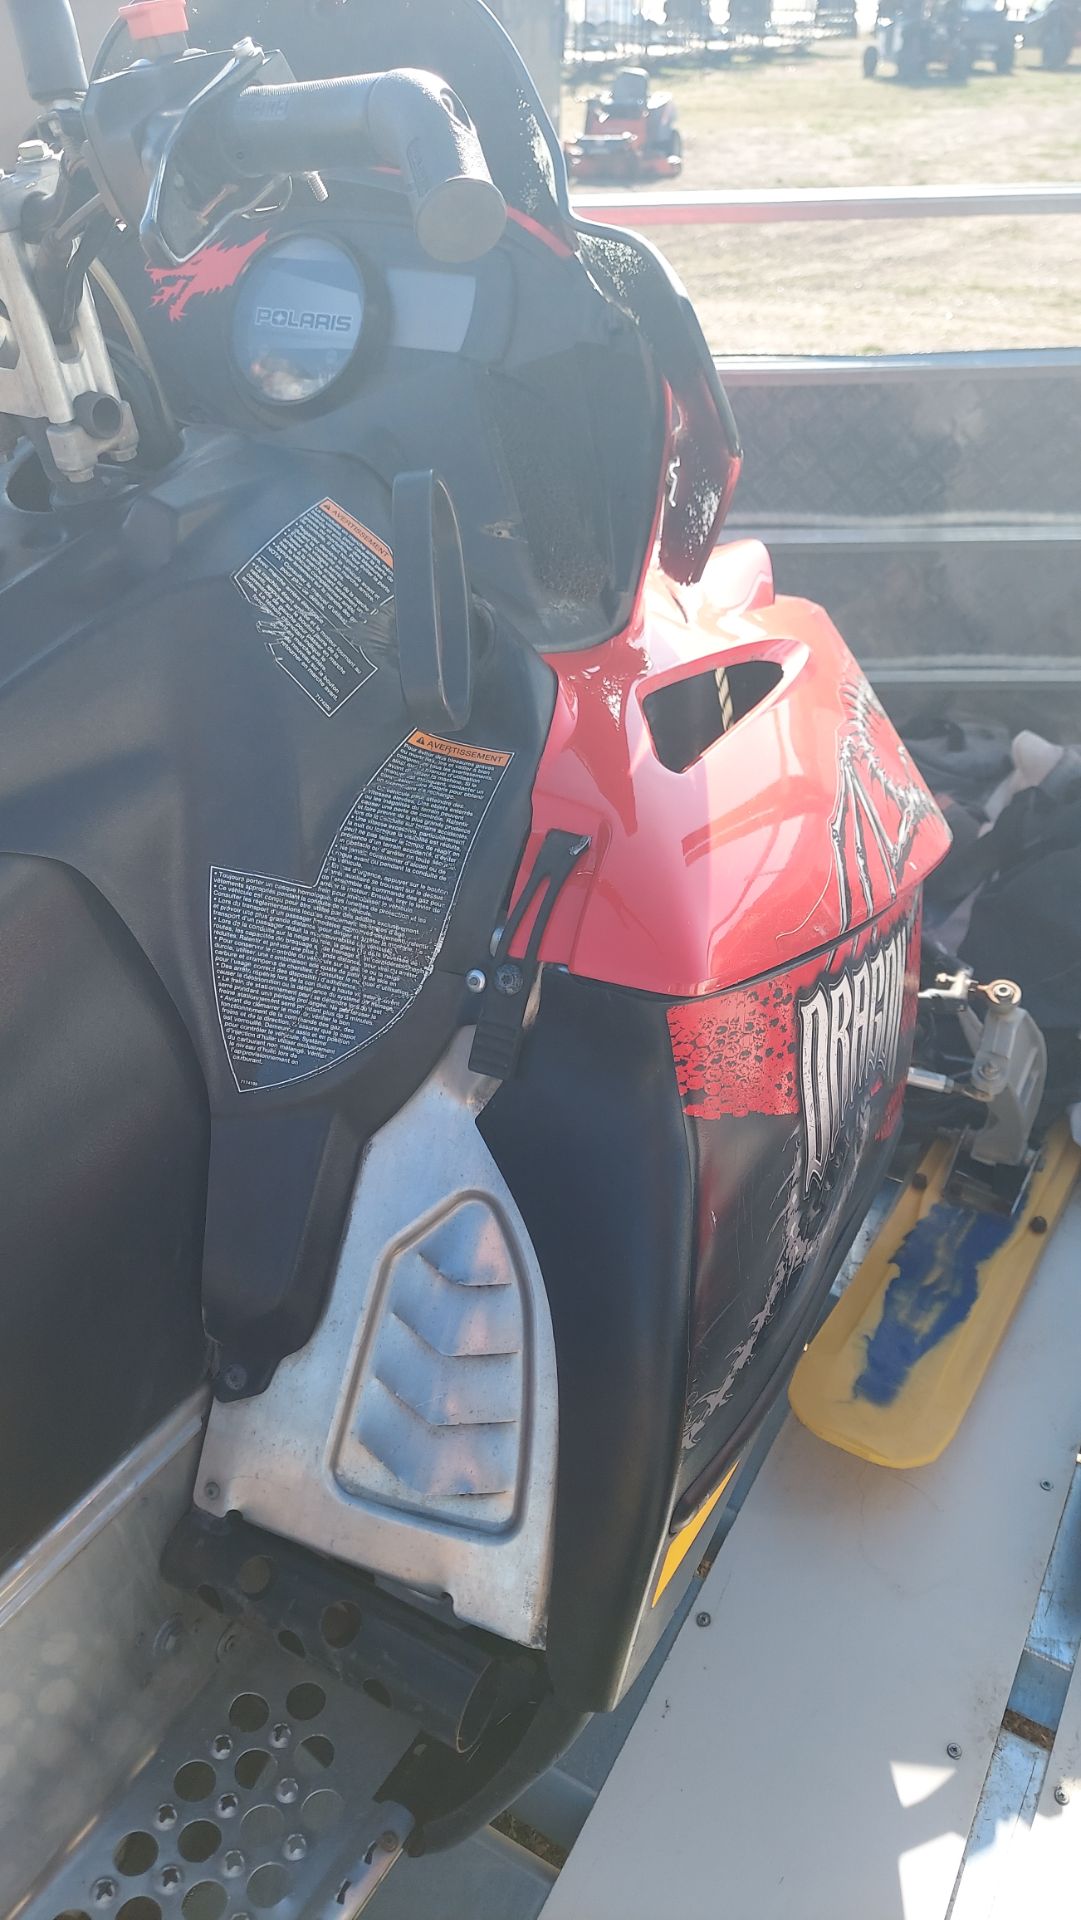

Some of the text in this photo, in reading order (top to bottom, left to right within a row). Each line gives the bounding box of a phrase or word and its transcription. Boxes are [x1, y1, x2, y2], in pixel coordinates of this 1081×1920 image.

[256, 307, 353, 332] POLARIS
[332, 510, 390, 558] AVERTISSEMENT
[265, 545, 282, 560] NOTA
[426, 738, 505, 763] AVERTISSEMENT
[800, 926, 907, 1196] DRAGON
